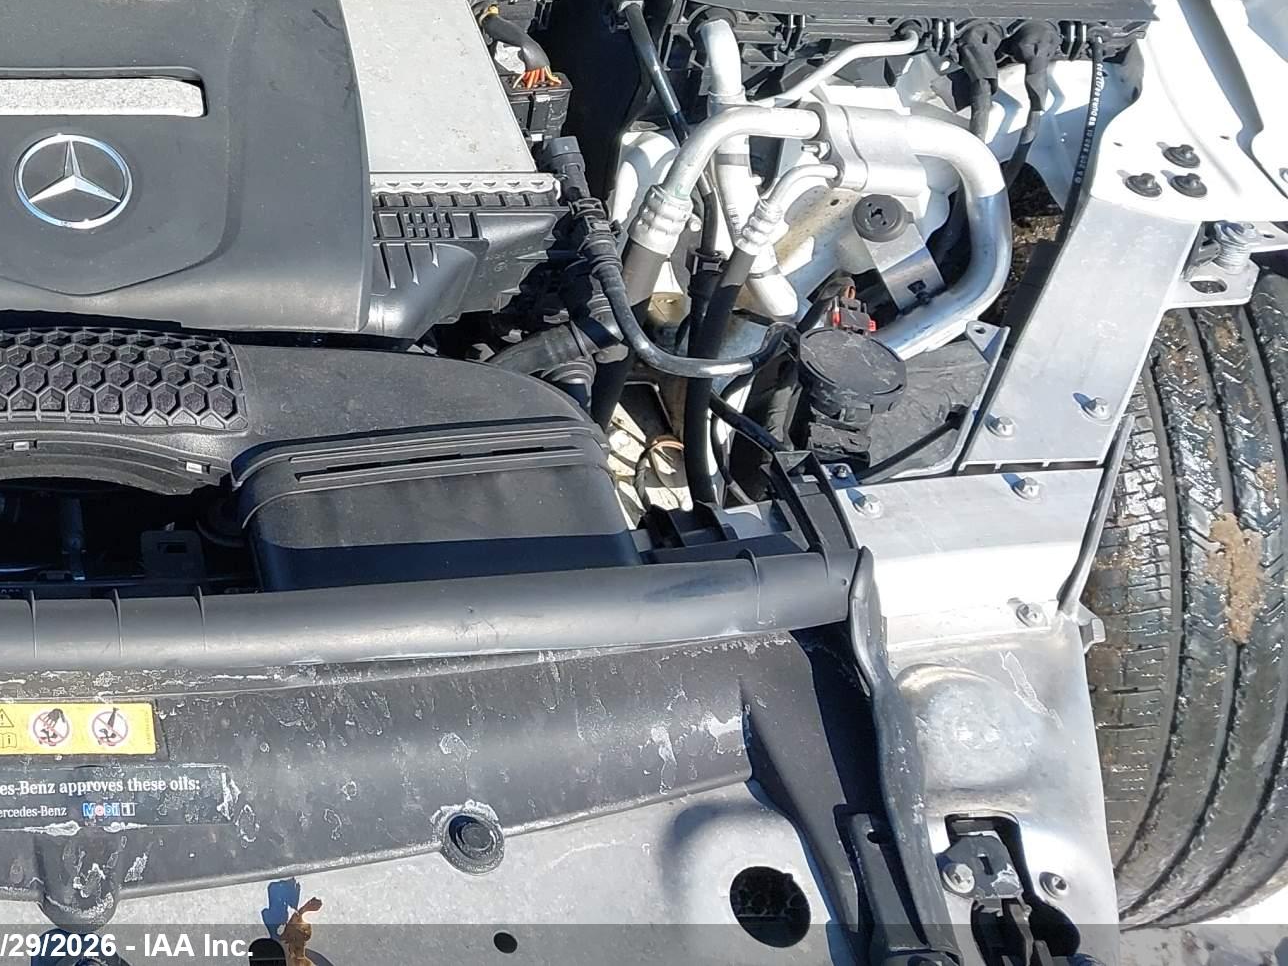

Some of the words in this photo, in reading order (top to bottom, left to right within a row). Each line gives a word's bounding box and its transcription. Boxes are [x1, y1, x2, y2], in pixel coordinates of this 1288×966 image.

[59, 780, 123, 796] approves
[127, 778, 166, 792] these
[169, 777, 201, 791] oils:
[82, 802, 121, 817] Mobil
